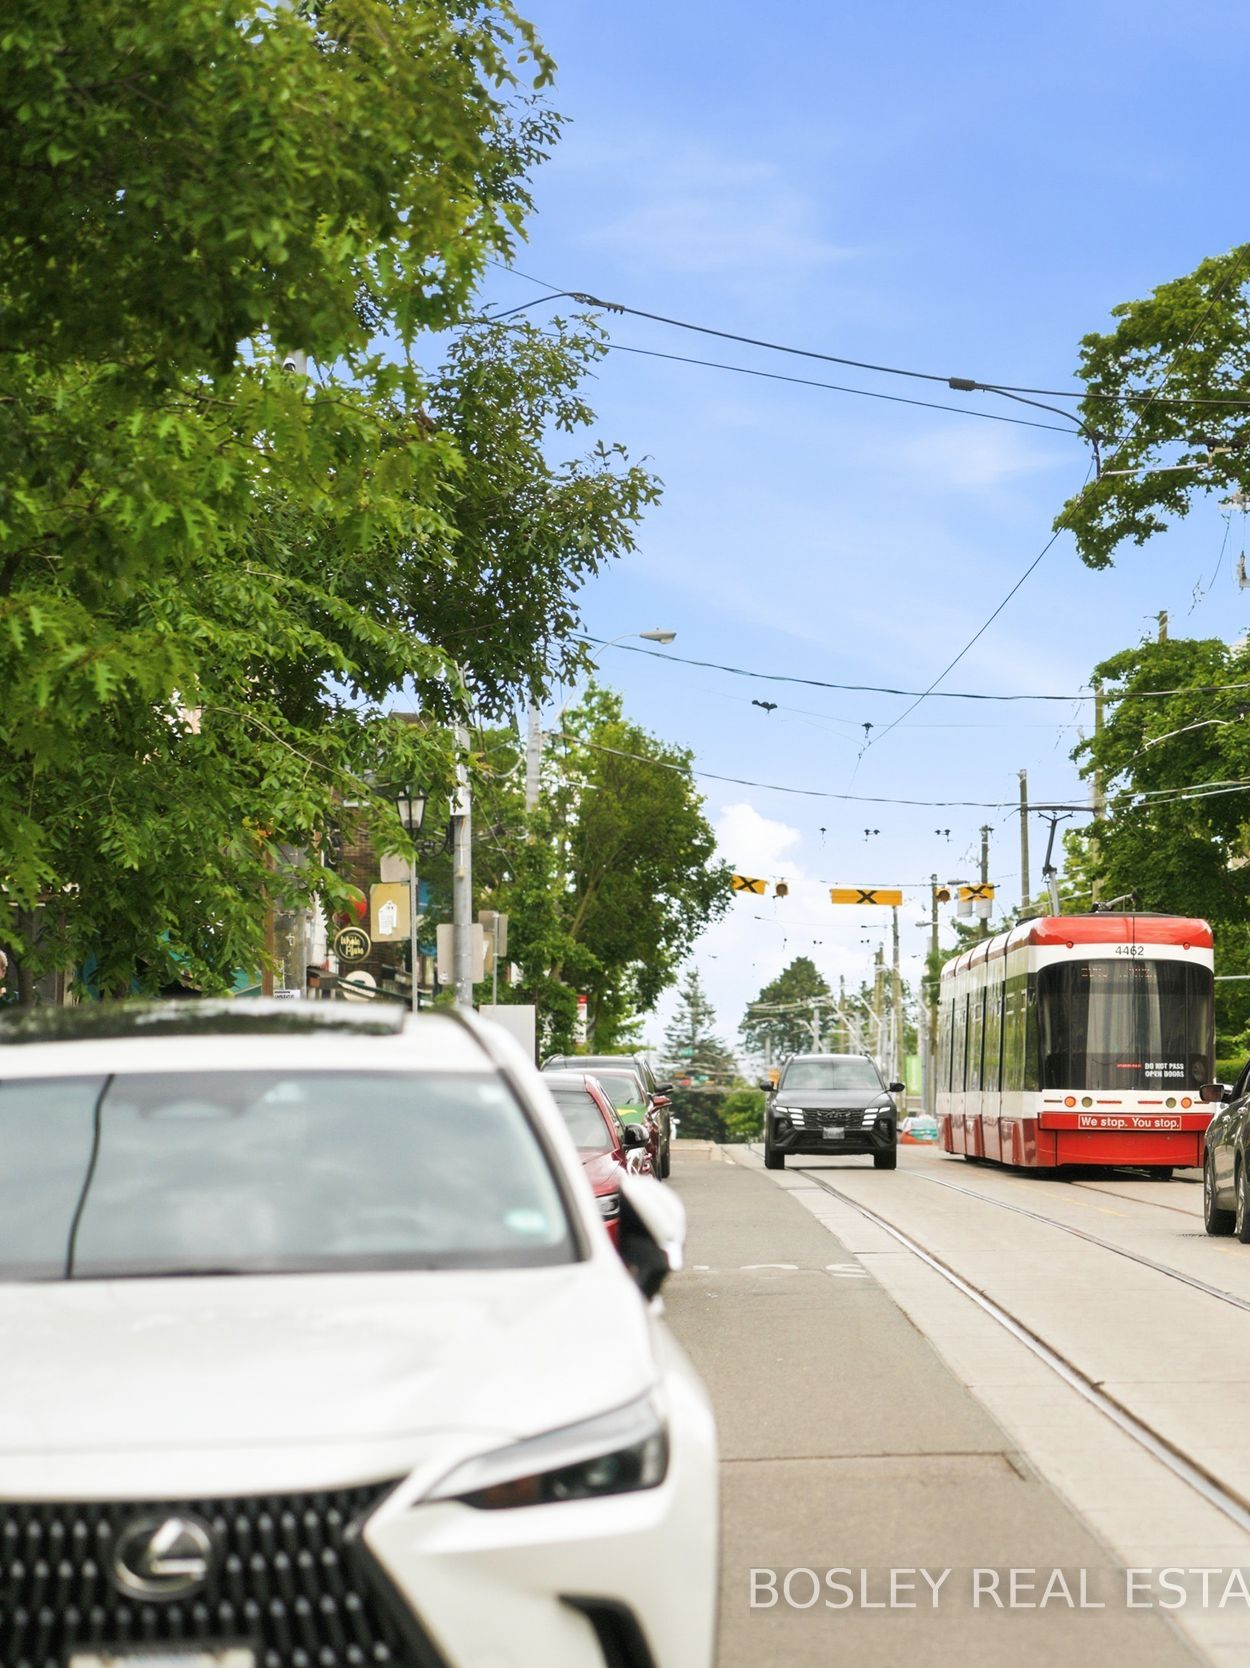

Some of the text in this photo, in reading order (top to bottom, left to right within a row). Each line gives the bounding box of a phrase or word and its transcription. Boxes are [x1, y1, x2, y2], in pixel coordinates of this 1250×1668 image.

[1115, 945, 1144, 956] 4462
[1081, 1117, 1180, 1129] We stop. You stop.
